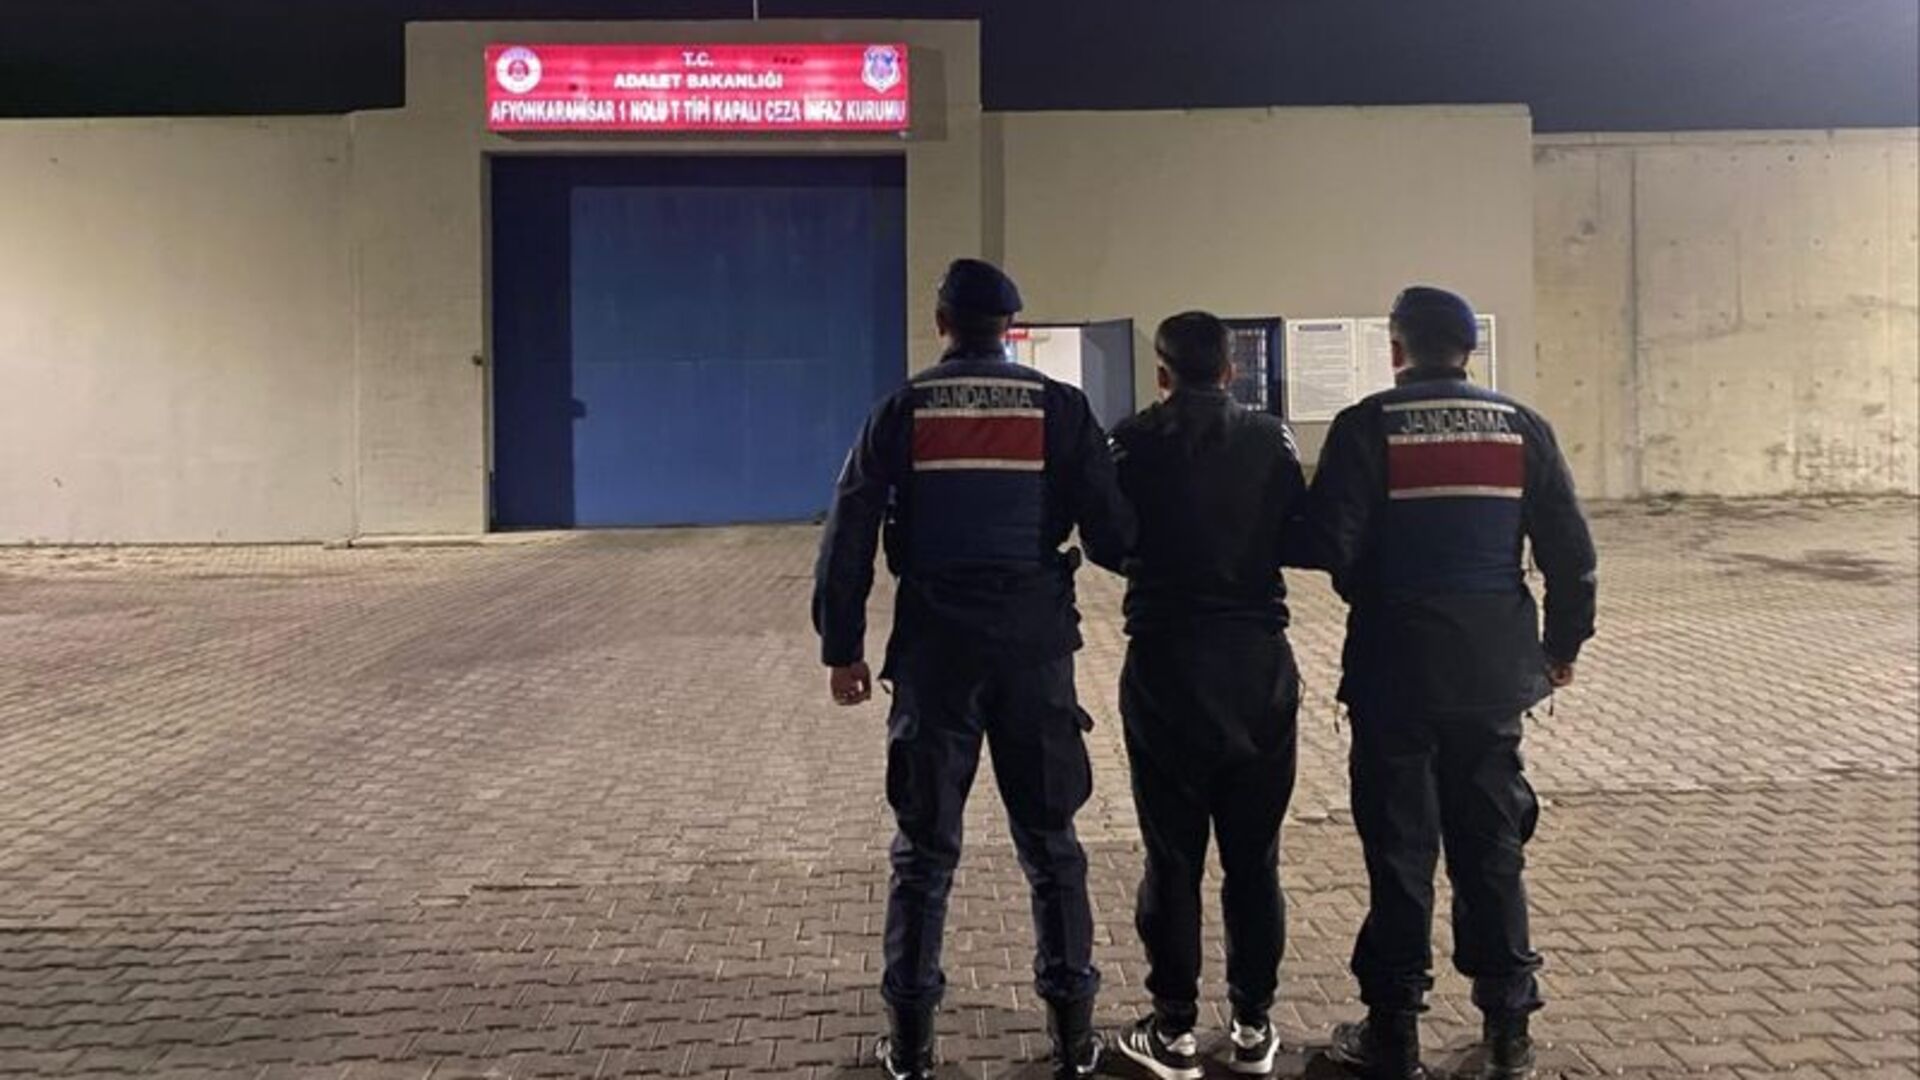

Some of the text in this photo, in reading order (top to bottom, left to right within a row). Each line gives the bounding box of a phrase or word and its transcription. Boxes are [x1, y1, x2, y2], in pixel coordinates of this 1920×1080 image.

[682, 52, 714, 67] T.C.
[613, 70, 784, 89] ADALET BAKANLIĞI
[618, 100, 626, 122] 1
[630, 99, 668, 123] NOLU
[670, 99, 681, 122] T
[713, 99, 761, 122] KAPALI
[846, 99, 907, 122] KURUMU
[924, 385, 1033, 409] JANDARMA
[1400, 408, 1512, 433] JANDARMA
